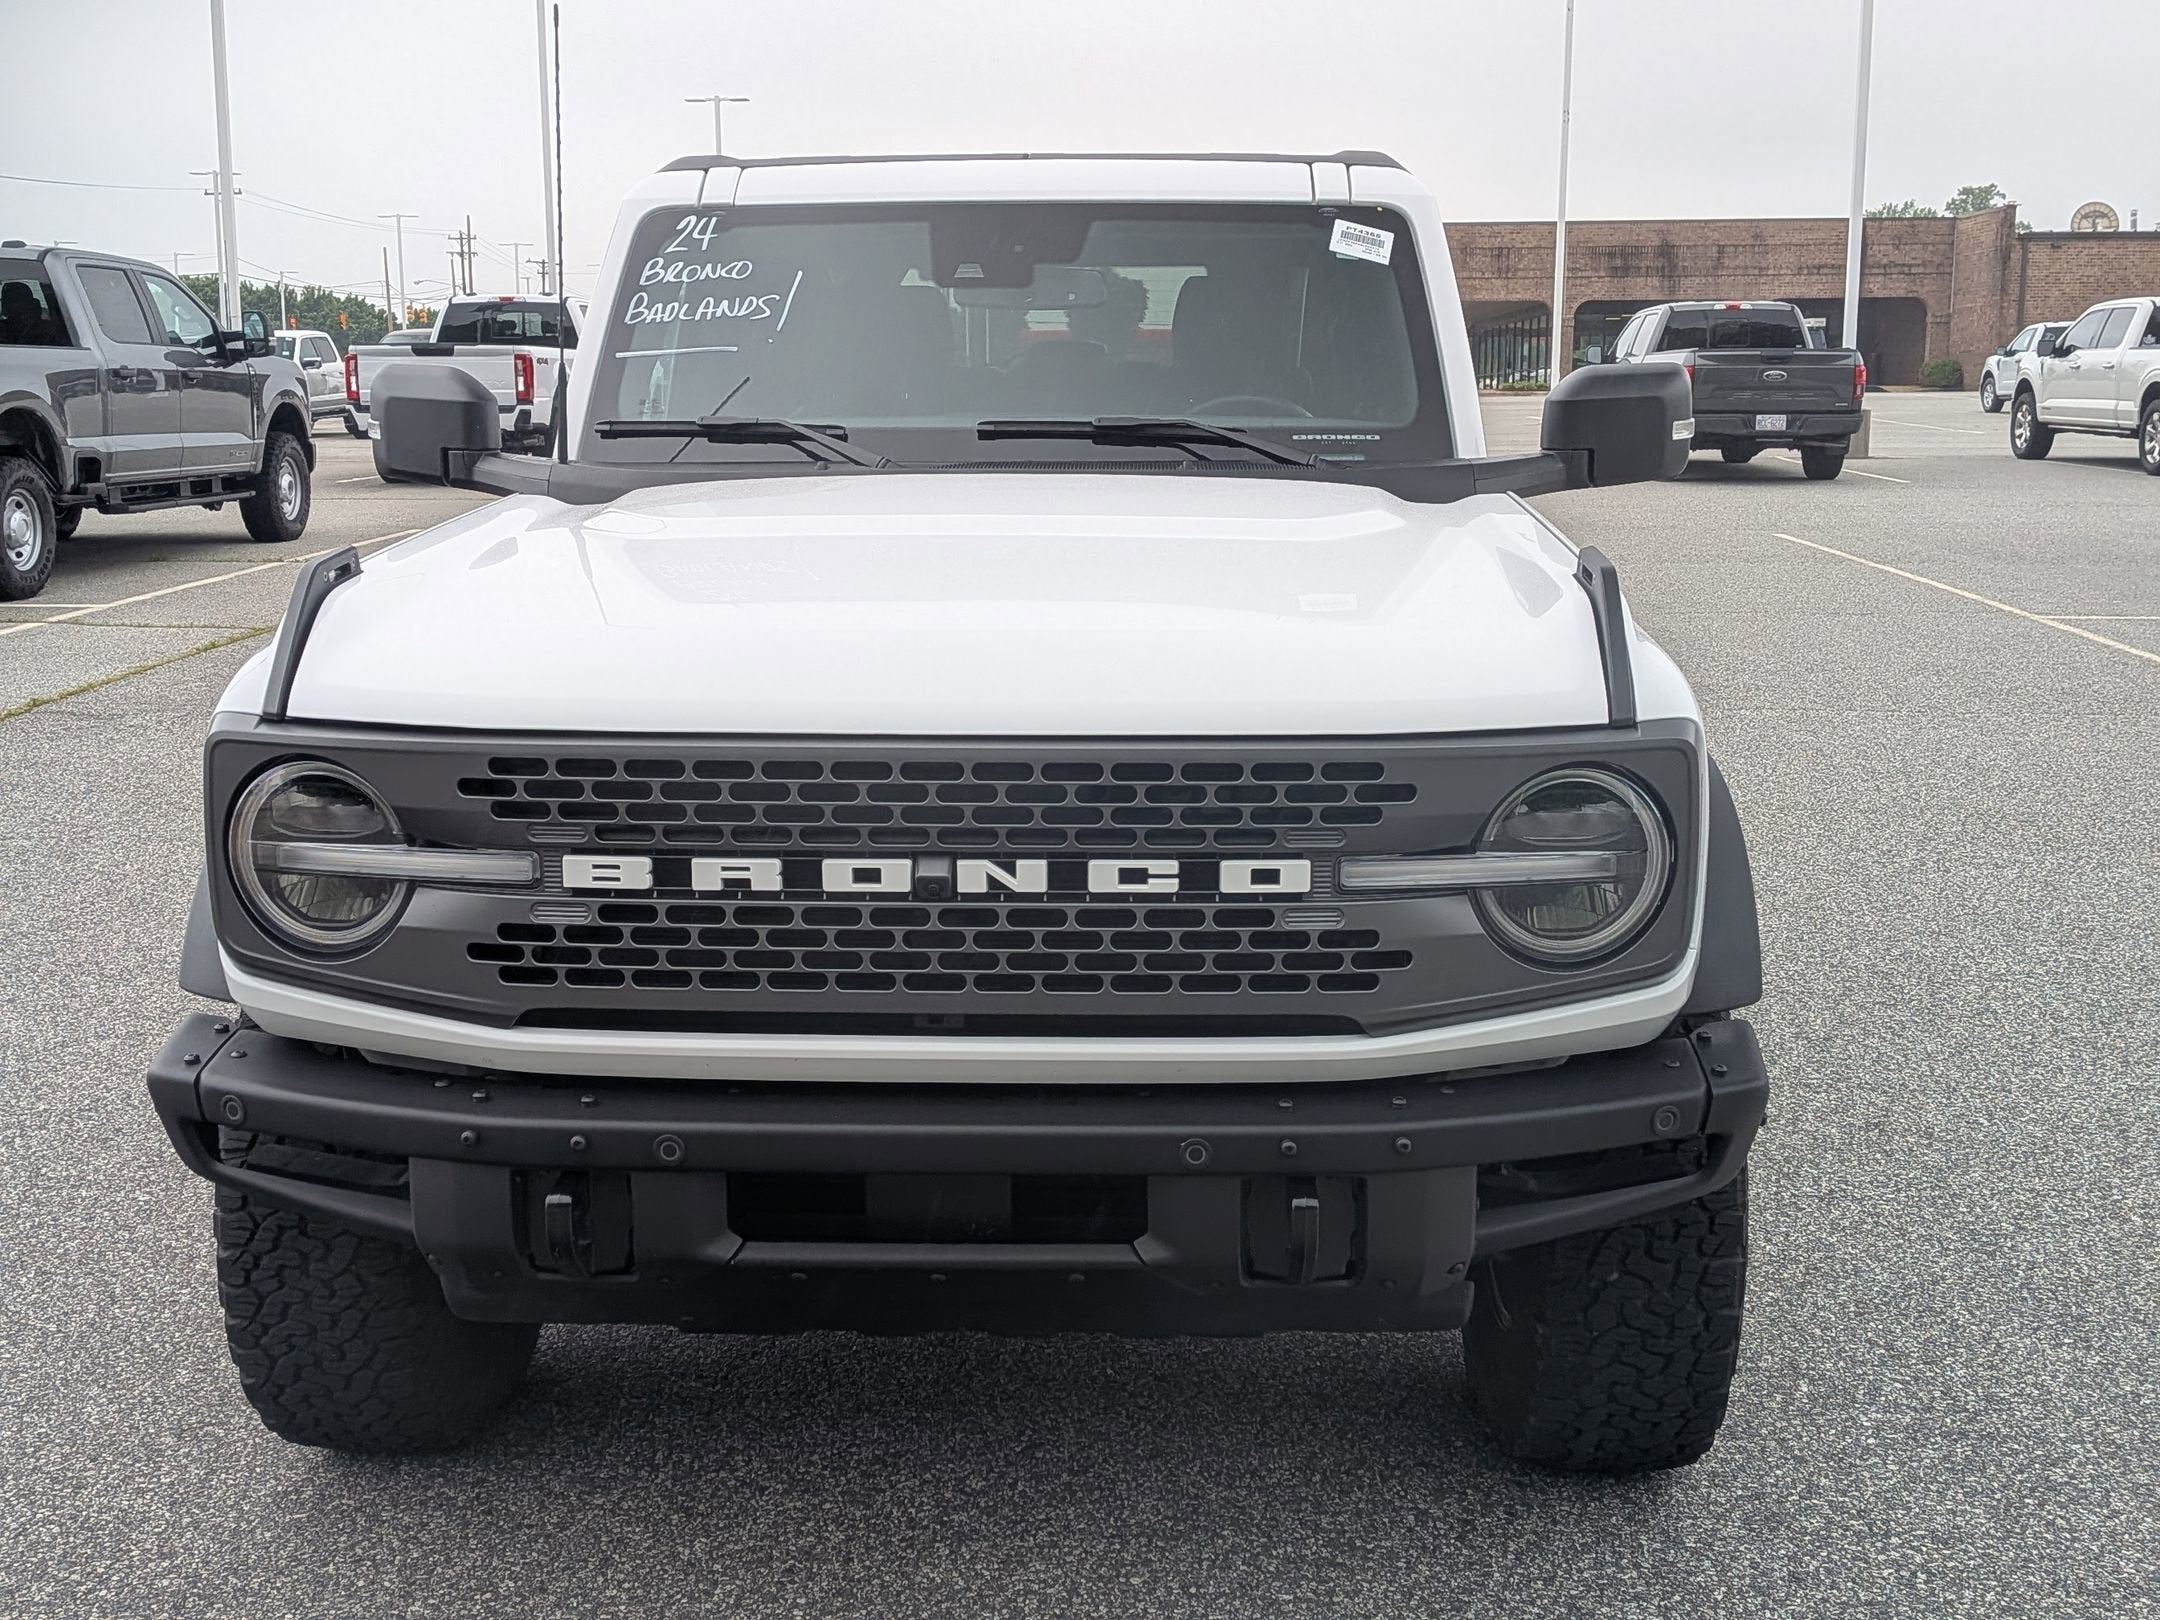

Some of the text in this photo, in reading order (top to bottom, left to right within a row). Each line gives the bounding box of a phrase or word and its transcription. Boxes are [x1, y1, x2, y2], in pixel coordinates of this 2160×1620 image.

[664, 215, 719, 253] 24
[639, 257, 753, 286] BRONCO
[562, 855, 1311, 893] BRONCO
